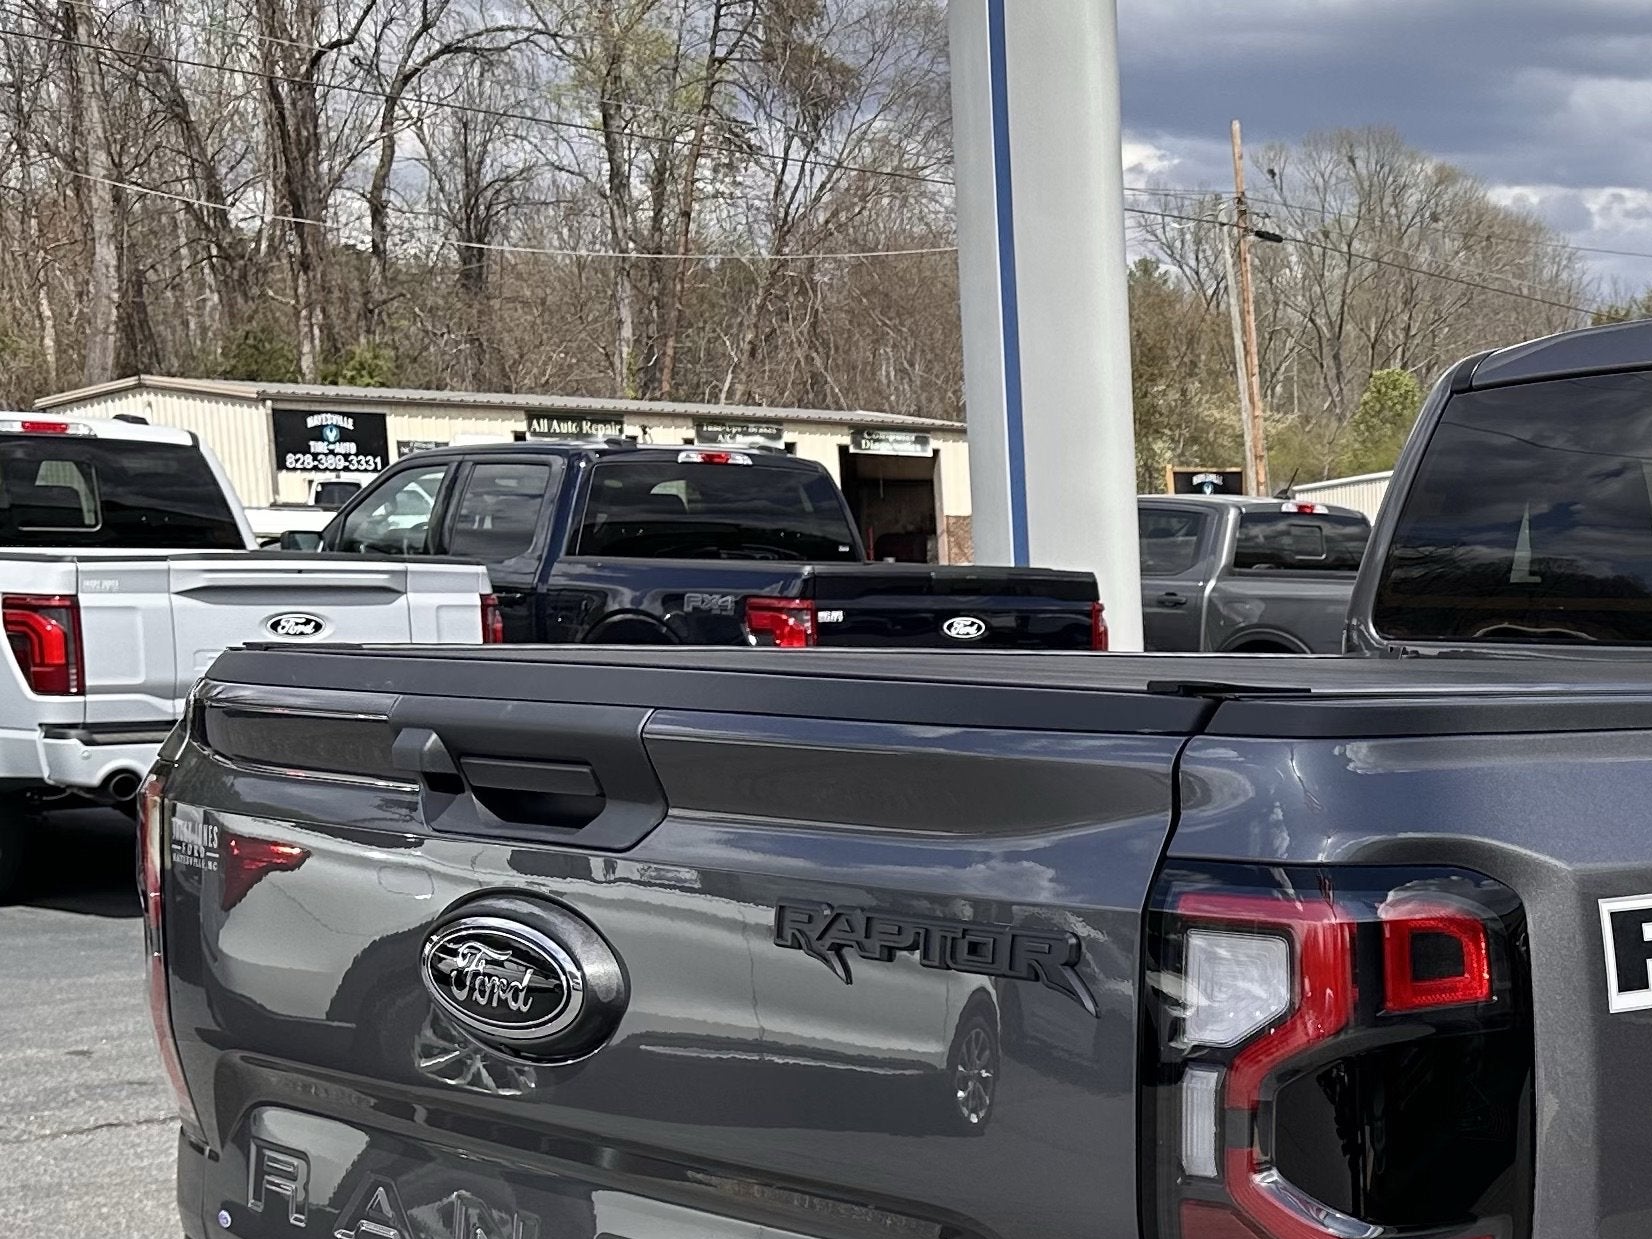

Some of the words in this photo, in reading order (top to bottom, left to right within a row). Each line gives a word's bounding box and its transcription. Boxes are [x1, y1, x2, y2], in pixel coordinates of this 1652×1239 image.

[530, 418, 548, 433] All
[550, 419, 579, 434] Auto
[582, 420, 621, 438] Repair
[285, 453, 382, 471] 828-389-3331
[683, 593, 735, 613] FX4
[774, 900, 1100, 1018] RAPTOR
[450, 941, 534, 1013] Ford
